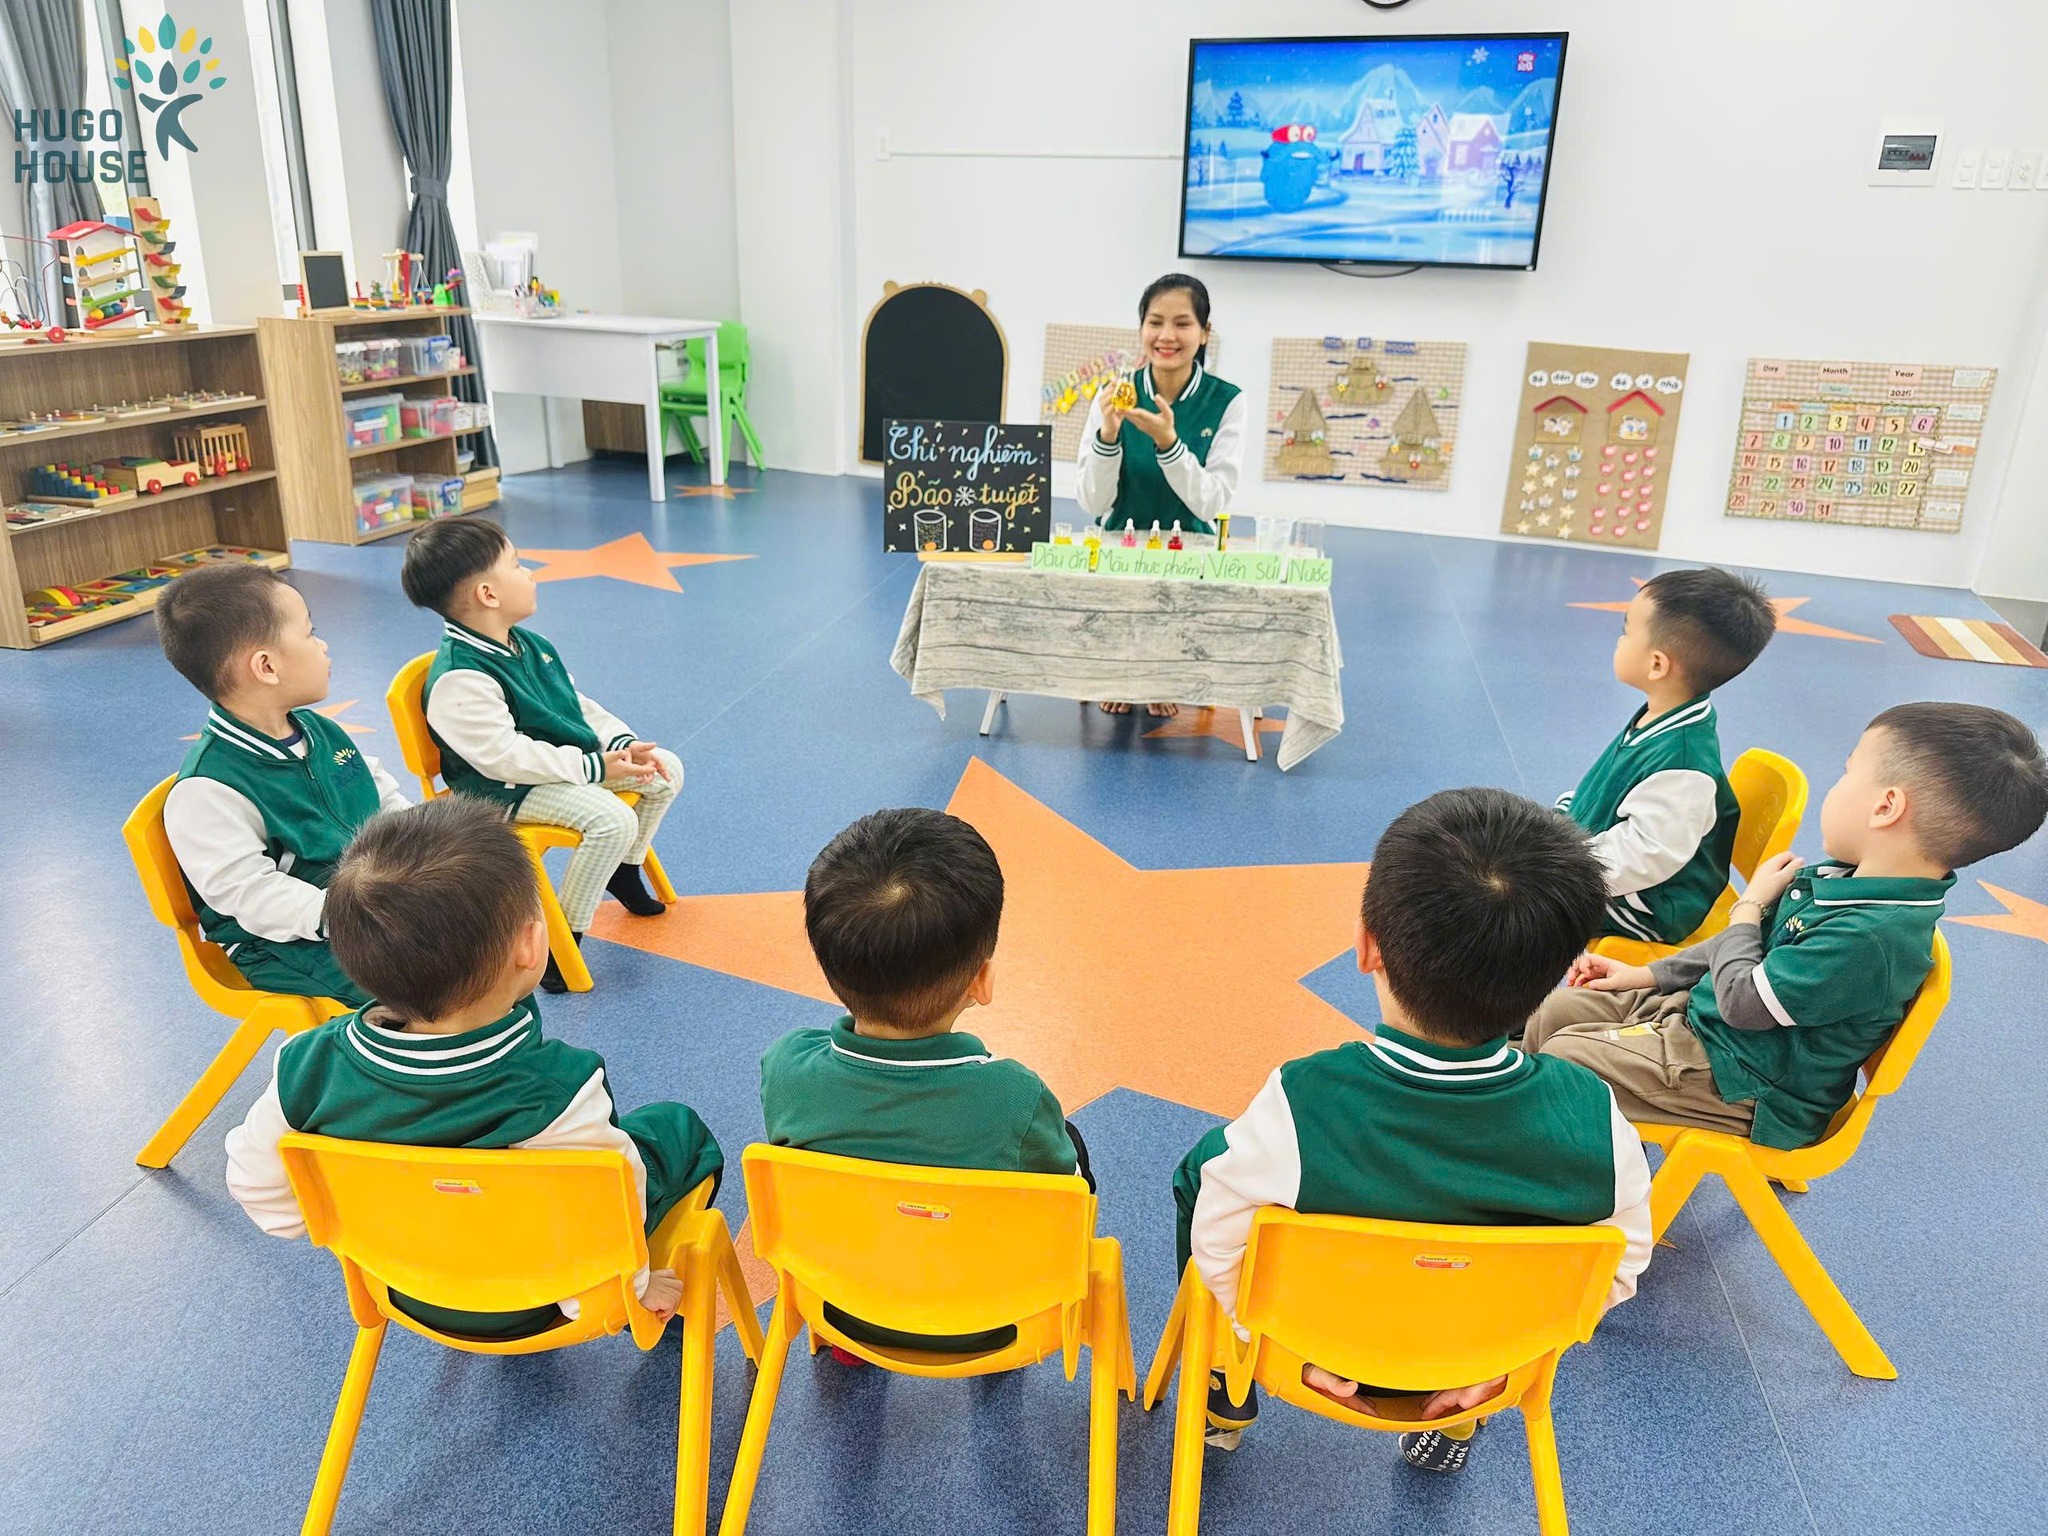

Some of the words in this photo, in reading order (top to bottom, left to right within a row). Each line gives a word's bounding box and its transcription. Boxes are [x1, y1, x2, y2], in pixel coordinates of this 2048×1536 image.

[1763, 365, 1779, 373] Day
[1823, 367, 1848, 375] Month
[1895, 370, 1914, 378] Year
[1783, 415, 1788, 428] 1
[1804, 416, 1813, 430] 2
[1835, 416, 1842, 428] 3
[1861, 417, 1870, 431] 4
[1890, 419, 1898, 432] 5
[1917, 417, 1927, 431] 6
[889, 425, 942, 462] Thí
[1751, 434, 1758, 447] 7
[1775, 435, 1785, 447] 8
[1802, 435, 1810, 447] 9
[1829, 438, 1841, 451] 10
[1858, 438, 1868, 450] 11
[1882, 438, 1894, 451] 12
[1744, 455, 1756, 467] 14
[1770, 457, 1781, 468] 15
[1796, 458, 1807, 471] 16
[1824, 460, 1836, 472] 17
[1851, 459, 1862, 472] 18
[1877, 461, 1889, 473] 19
[1904, 461, 1919, 474] 20
[889, 471, 952, 509] Bão
[979, 473, 1040, 520] tuyết
[1738, 475, 1750, 487] 21
[1764, 478, 1779, 489] 22
[1790, 477, 1806, 489] 23
[1817, 477, 1834, 490] 24
[1846, 482, 1861, 494] 25
[1872, 481, 1888, 494] 26
[1900, 483, 1916, 496] 27
[1732, 495, 1745, 507] 28
[1760, 501, 1775, 513] 29
[1788, 501, 1803, 513] 30
[1818, 504, 1830, 516] 31
[1068, 550, 1088, 570] ăn
[1207, 553, 1247, 580] Viên
[1290, 559, 1330, 583] Nước
